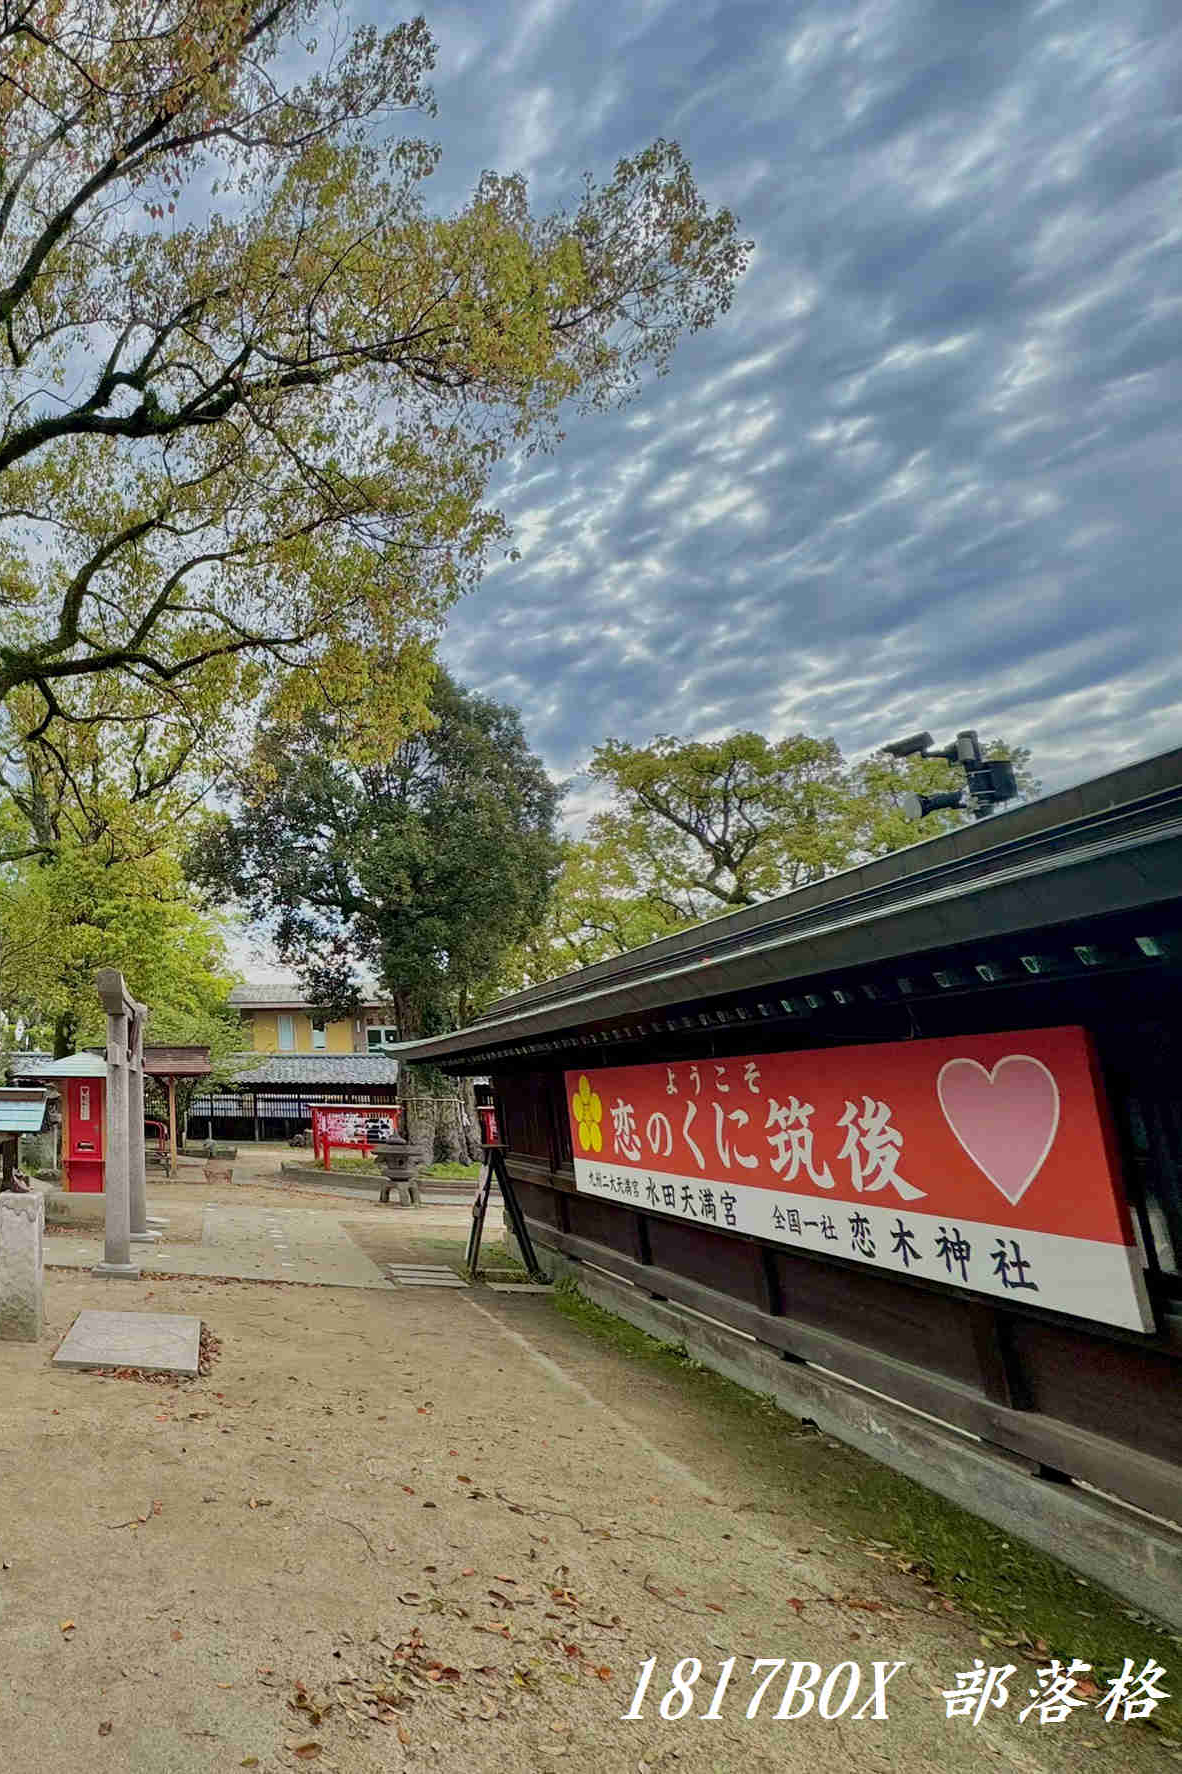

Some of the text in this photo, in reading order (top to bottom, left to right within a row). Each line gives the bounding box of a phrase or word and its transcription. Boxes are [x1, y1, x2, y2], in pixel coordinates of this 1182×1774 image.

[665, 1061, 763, 1095] ようこそ
[610, 1094, 928, 1201] 恋のくに筑後
[645, 1176, 738, 1227] 水田天満宮
[771, 1203, 839, 1241] 全国一社
[848, 1210, 1039, 1292] 恋木神社
